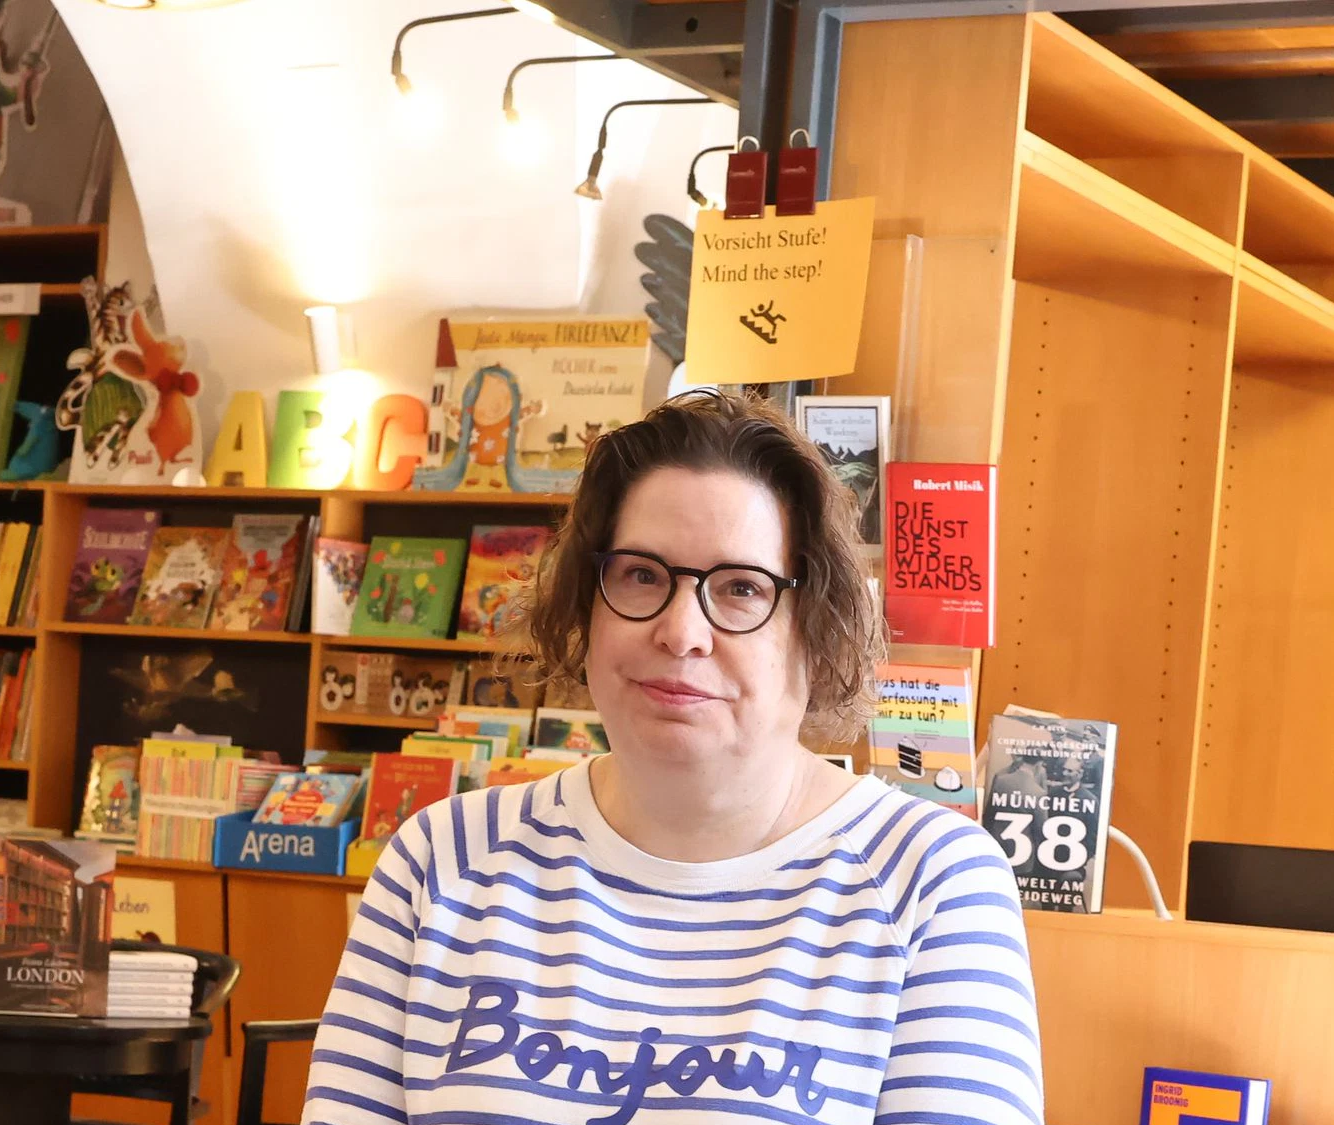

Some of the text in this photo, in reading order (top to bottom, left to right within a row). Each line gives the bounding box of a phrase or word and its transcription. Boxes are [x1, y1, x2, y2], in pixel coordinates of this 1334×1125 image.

[703, 227, 827, 250] Vorsicht Stufe!
[703, 260, 823, 283] Mind the step!
[913, 479, 984, 491] Robert Misik
[895, 501, 934, 520] DIE
[895, 519, 969, 538] KUNST
[895, 536, 941, 555] DES
[895, 553, 974, 576] WIDER
[895, 571, 982, 591] STANDS
[901, 677, 940, 691] hat die
[942, 697, 958, 708] mit
[899, 711, 912, 720] zu
[997, 738, 1100, 750] CHRISTIAN GOESCHEL
[1005, 748, 1091, 760] DANIEL HEDINGER
[992, 791, 1096, 813] MÜNCHEN
[240, 831, 315, 862] Arena
[995, 812, 1088, 871] 38
[1018, 877, 1084, 892] WELT AM
[7, 966, 85, 984] LONDON
[1155, 1084, 1182, 1096] INGRID
